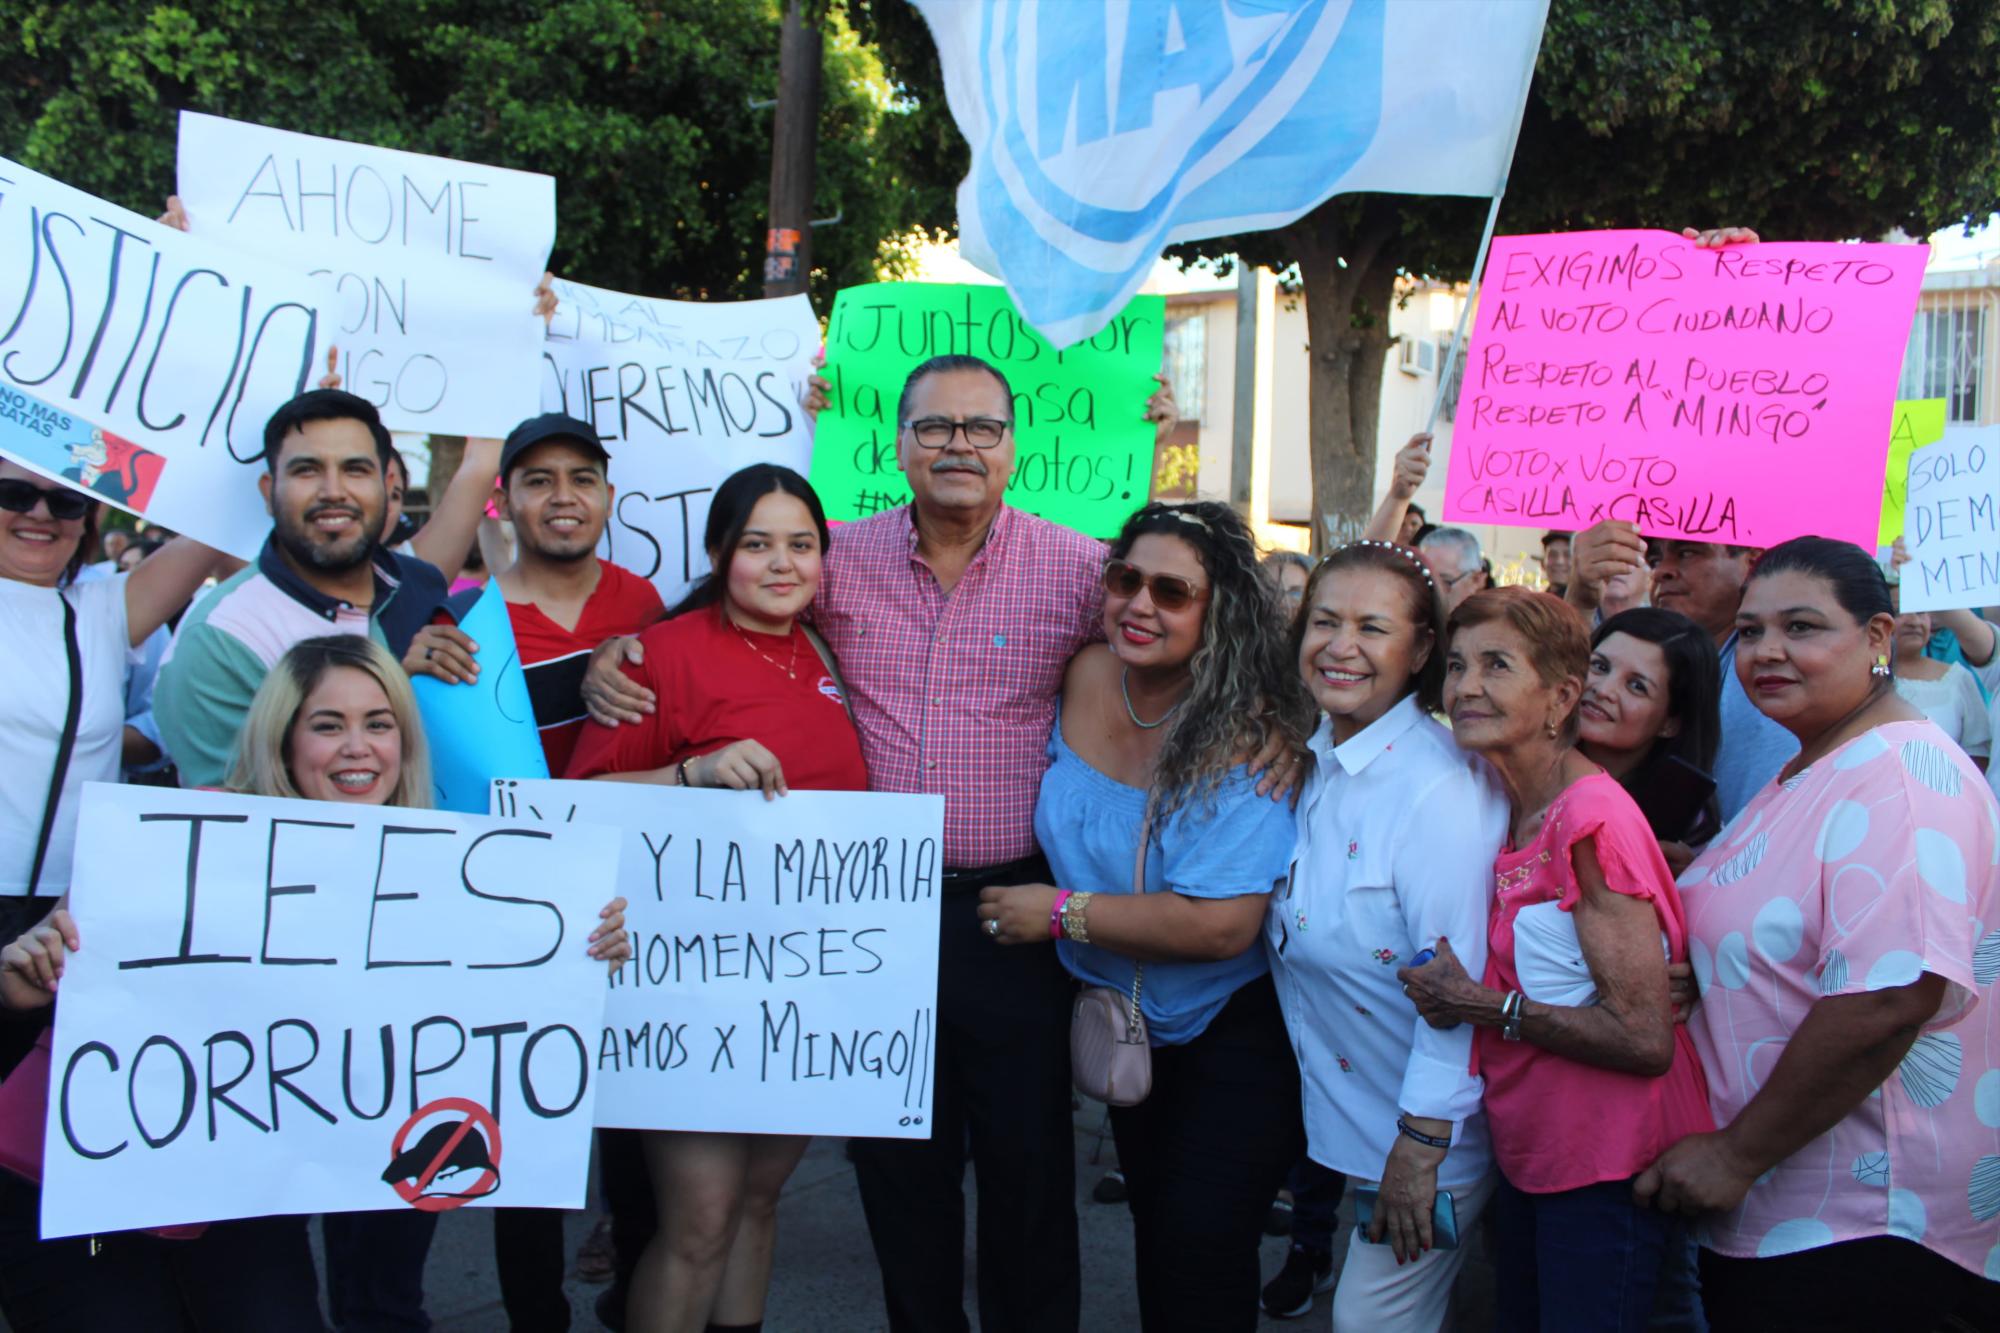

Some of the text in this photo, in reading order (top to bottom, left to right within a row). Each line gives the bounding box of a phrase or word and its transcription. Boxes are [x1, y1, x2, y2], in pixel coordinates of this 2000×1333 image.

[227, 153, 493, 261] AHOME
[1501, 243, 1894, 292] EXIGIMOS RESPETO
[308, 268, 406, 336] ON
[1490, 297, 1834, 334] AL VOTO CIUDADANO
[1057, 316, 1152, 364] or
[836, 364, 884, 424] la
[1011, 382, 1095, 430] nsa
[1481, 343, 1829, 396] RESPETO AL PUEBLO
[0, 387, 73, 432] NO MAS
[1473, 395, 1607, 431] RESPETO
[1623, 391, 1648, 432] A
[1006, 435, 1133, 501] votos!
[1579, 443, 1677, 488] VOTO
[1911, 444, 1986, 493] SOLO
[1457, 484, 1580, 520] CASILLA
[1916, 493, 2000, 548] DEM
[606, 488, 713, 583] ST
[119, 812, 565, 970] IEES
[641, 831, 936, 905] Y LA MAYORIA
[609, 927, 888, 989] HOMENSES
[60, 1015, 590, 1161] CORRUPTO
